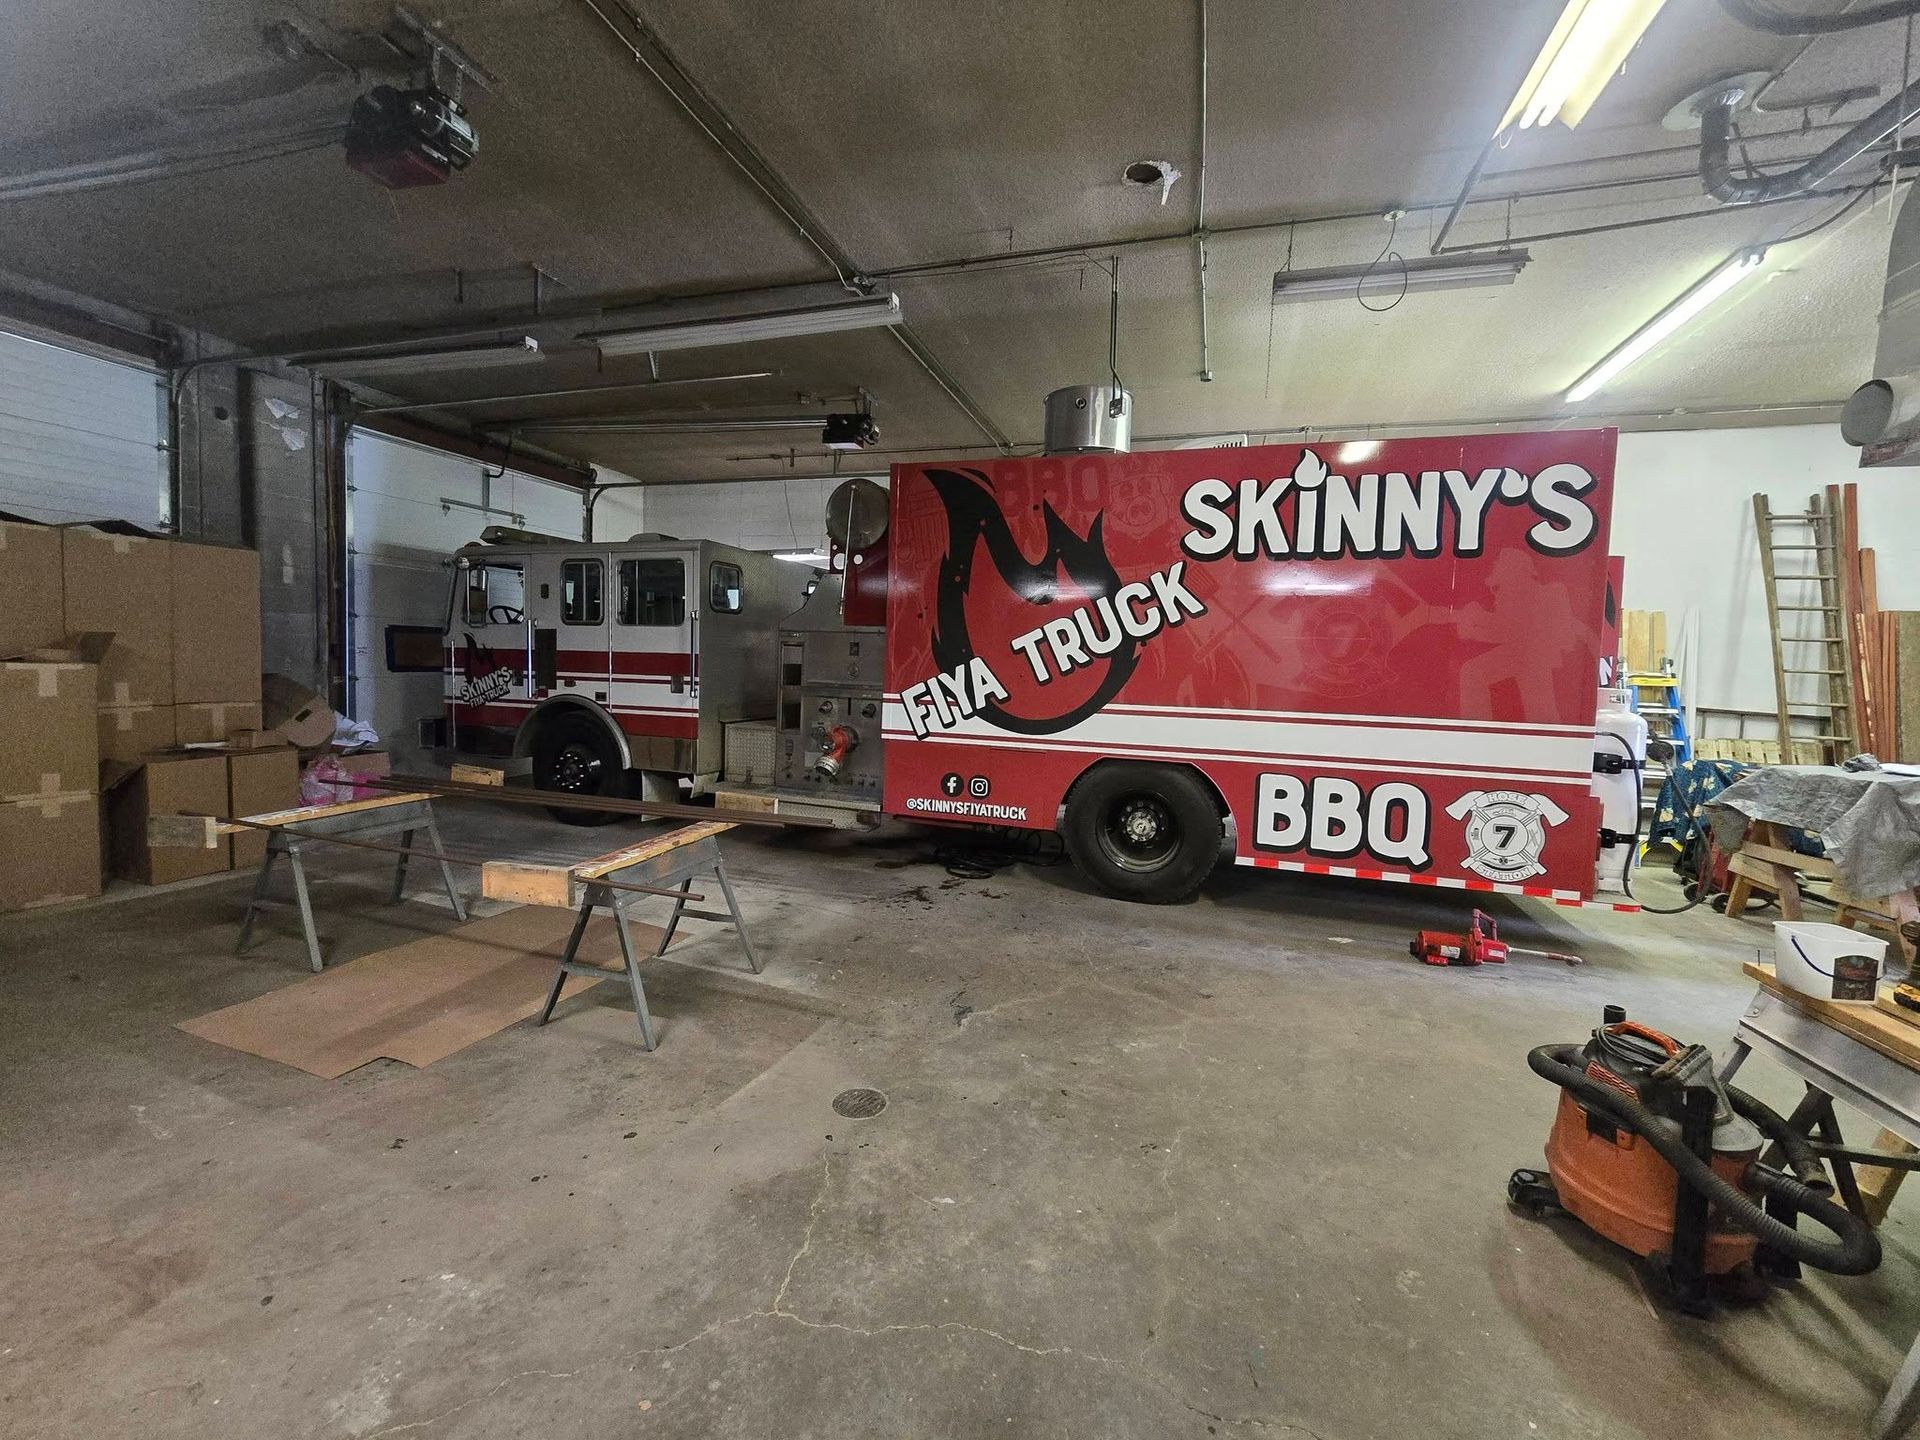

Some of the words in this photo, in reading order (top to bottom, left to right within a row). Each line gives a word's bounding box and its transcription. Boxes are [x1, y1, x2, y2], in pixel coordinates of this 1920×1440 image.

[900, 655, 1011, 739] FIYA
[1011, 561, 1206, 685] TRUCK
[485, 682, 510, 701] TRUCK
[906, 798, 1027, 820] @SKINNYSFIYATRUCK
[1253, 772, 1433, 873] BBQ
[1493, 823, 1517, 850] 7
[1476, 865, 1533, 881] STATION
